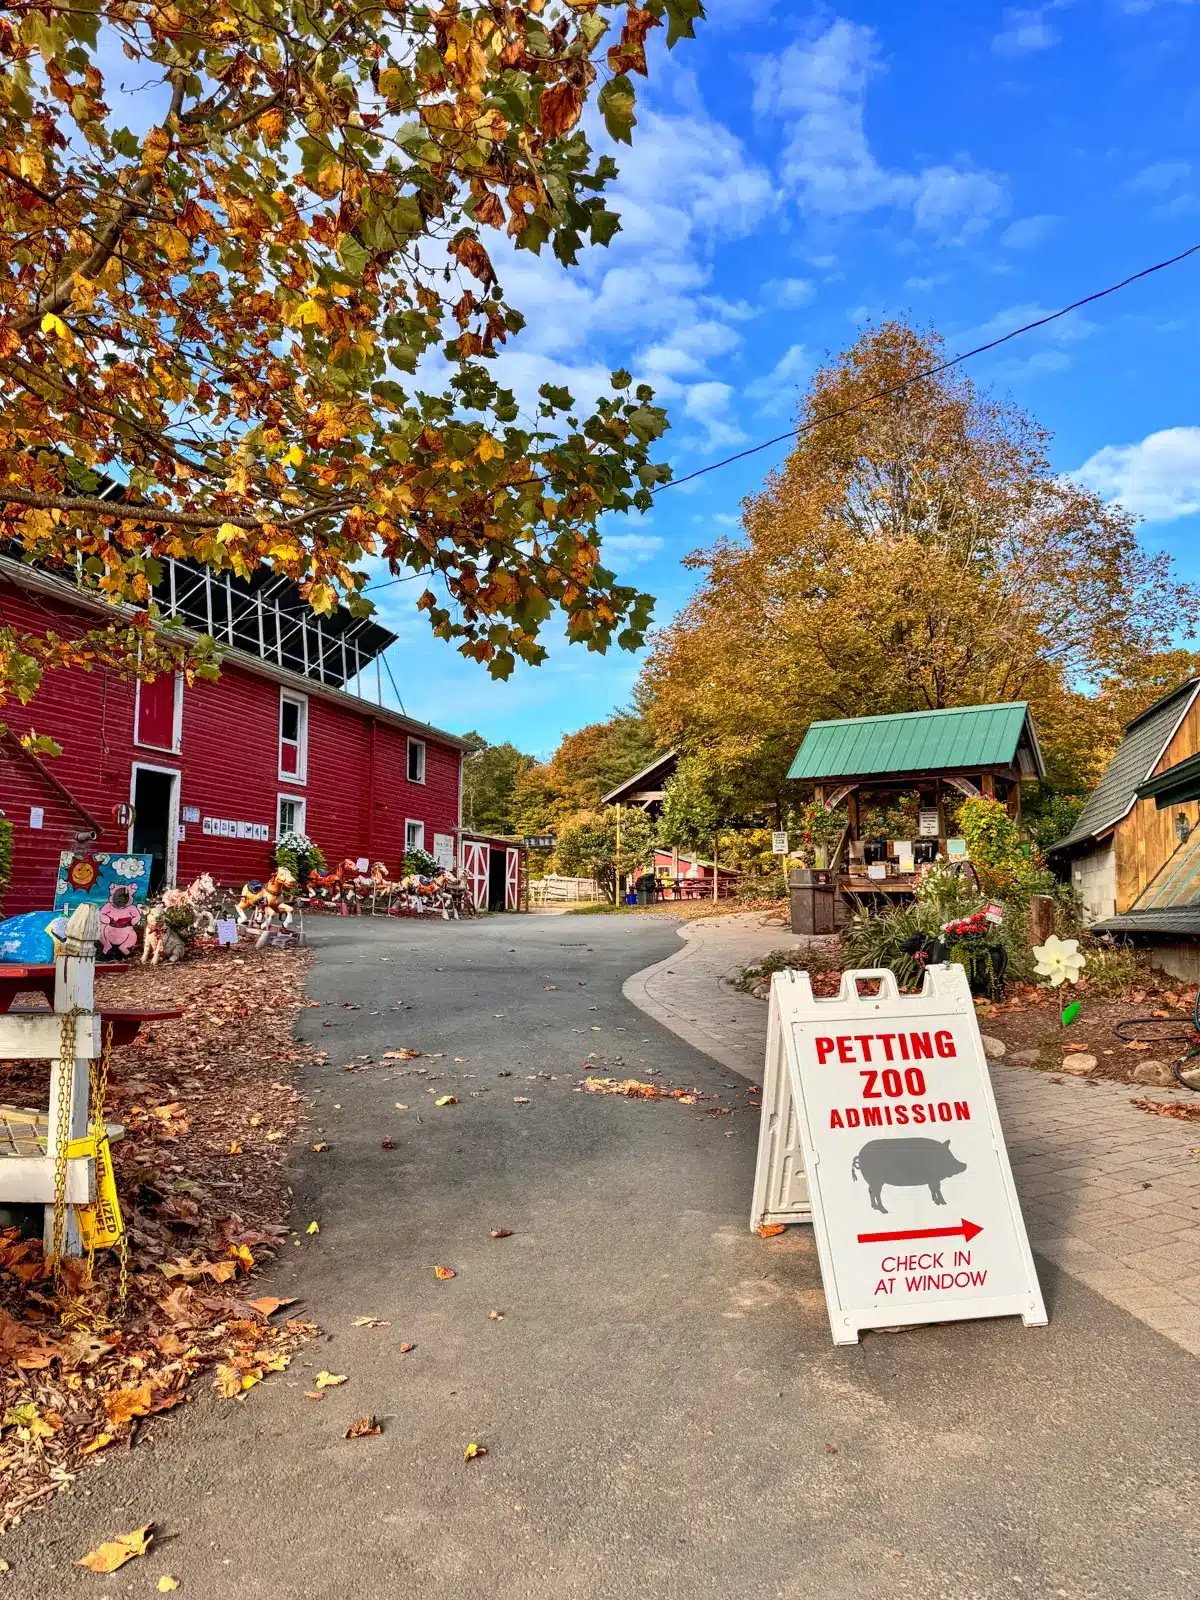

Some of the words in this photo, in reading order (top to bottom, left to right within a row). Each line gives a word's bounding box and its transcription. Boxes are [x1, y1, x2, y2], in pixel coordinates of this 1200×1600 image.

[814, 1029, 958, 1065] PETTING
[858, 1067, 927, 1099] ZOO
[829, 1100, 971, 1129] ADMISSION
[881, 1252, 945, 1273] CHECK
[953, 1250, 972, 1267] IN
[874, 1277, 897, 1295] AT
[905, 1270, 988, 1292] WINDOW
